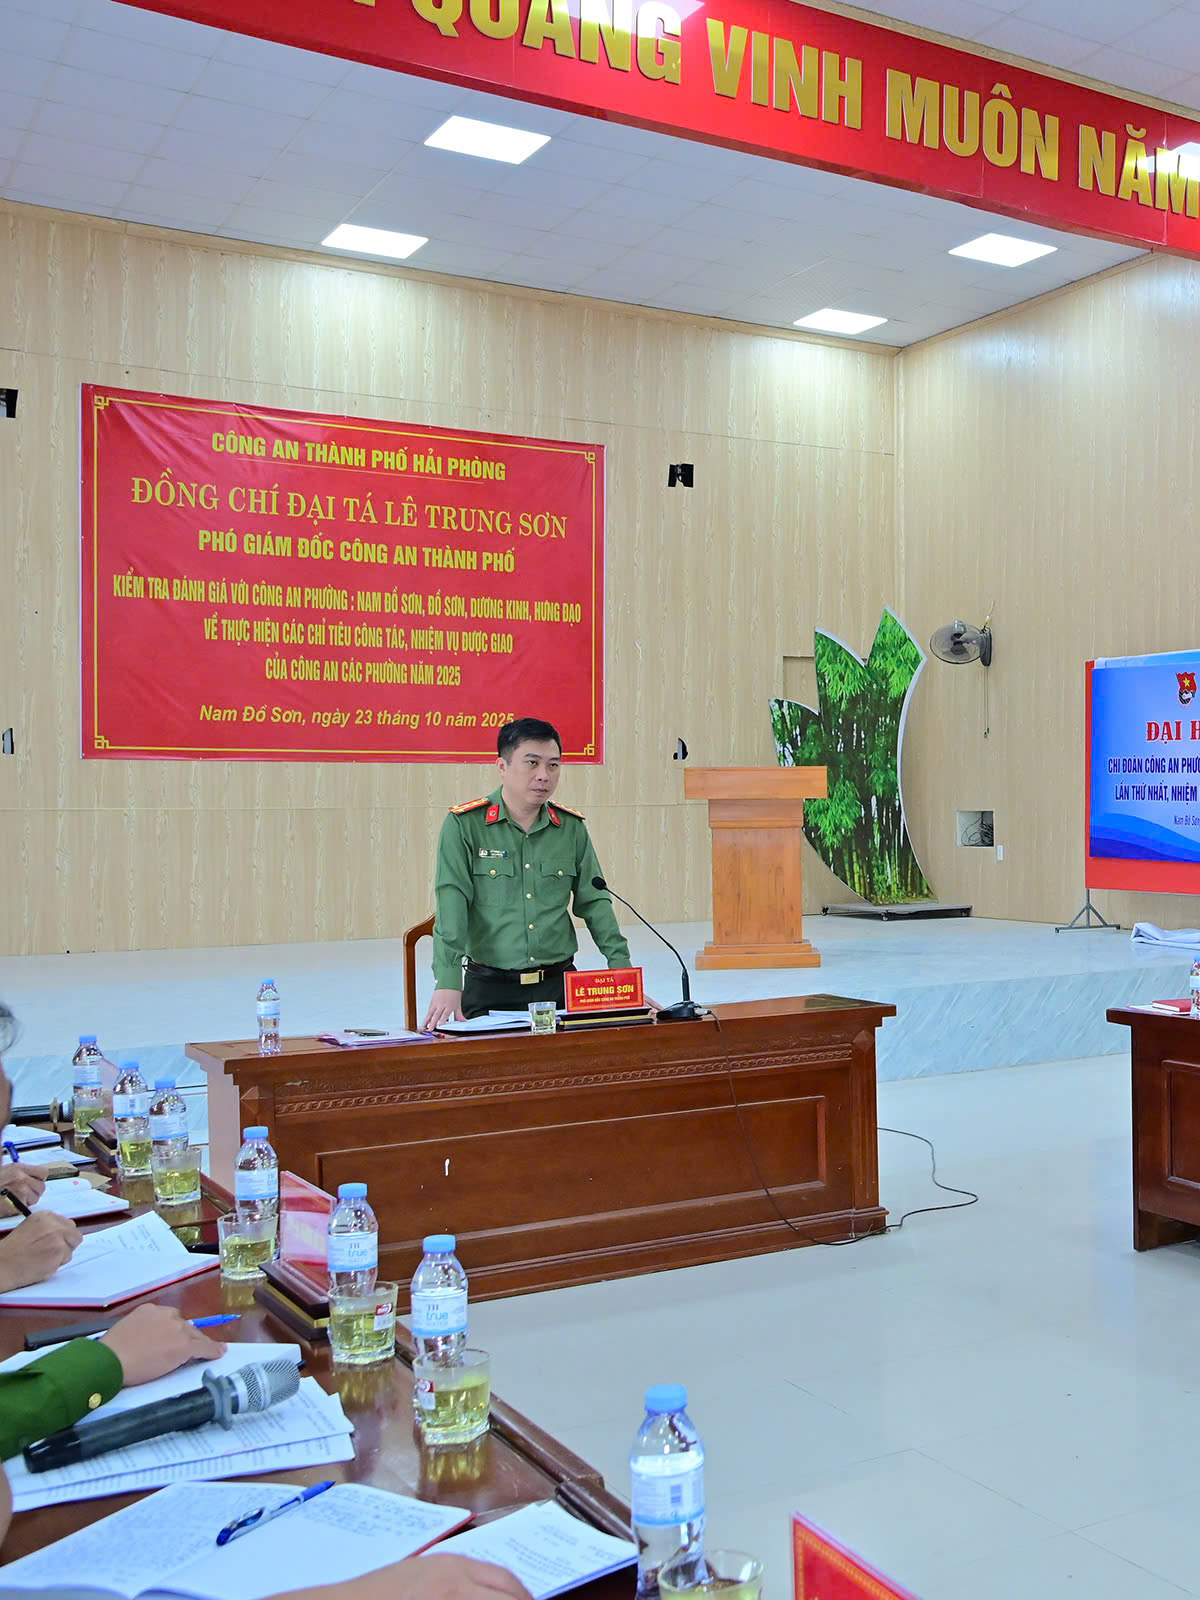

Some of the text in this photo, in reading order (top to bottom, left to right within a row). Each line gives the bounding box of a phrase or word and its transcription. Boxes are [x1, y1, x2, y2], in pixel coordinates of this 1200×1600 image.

[705, 17, 863, 130] VINH
[885, 68, 1060, 182] MUÔN
[1079, 123, 1199, 218] NĂM
[212, 430, 506, 480] CÔNG AN THÀNH PHỐ HẢI PHÒNG
[131, 467, 567, 539] ĐỒNG CHÍ ĐẠI TÁ LÊ TRUNG SƠN
[199, 528, 515, 572] PHÓ GIÁM ĐỐC CÔNG AN THÀNH PHỐ
[113, 567, 144, 598] KIỂM
[148, 577, 170, 600] TRA
[173, 576, 205, 602] ĐÁNH
[231, 579, 249, 605] VỚI
[252, 580, 282, 607] CÔNG
[286, 586, 301, 608] AN
[304, 584, 348, 611] PHƯỜNG
[357, 591, 381, 613] NAM
[384, 586, 398, 613] ĐỒ
[401, 592, 425, 617] SƠN,
[428, 589, 441, 616] ĐỒ
[444, 595, 468, 620] SƠN,
[470, 597, 504, 619] DƯƠNG
[506, 600, 532, 623] KINH,
[534, 601, 560, 622] HƯNG
[563, 603, 582, 627] ĐẠO
[204, 612, 513, 656] VỀ THỰC HIỆN CÁC CHỈ TIÊU CÔNG TÁC, NHIỆM VỤ ĐƯỢC GIAO
[265, 652, 461, 686] CỦA CÔNG AN CÁC PHƯỜNG NĂM 2025
[200, 704, 514, 729] Nam Đồ Sơn, ngày 23 tháng 10 năm 2025
[1146, 720, 1182, 744] ĐẠI
[575, 984, 635, 997] LÊ TRUNG SƠN
[426, 1311, 449, 1320] true
